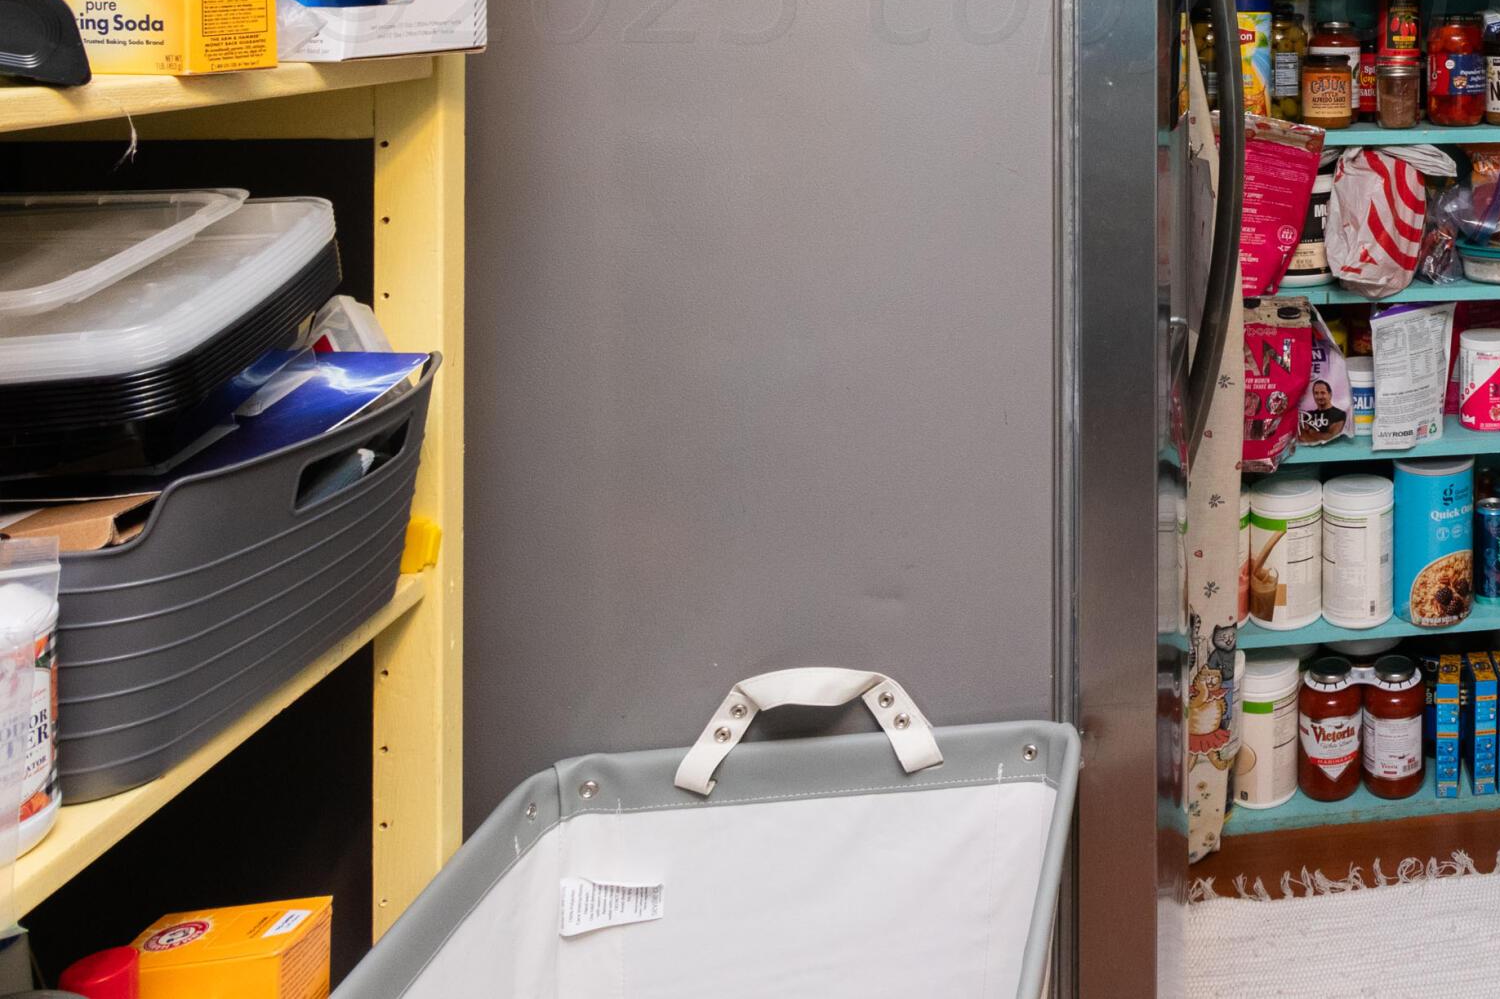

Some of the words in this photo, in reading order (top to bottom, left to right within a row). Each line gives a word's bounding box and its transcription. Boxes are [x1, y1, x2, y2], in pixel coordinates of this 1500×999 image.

[86, 0, 117, 12] pure
[113, 14, 164, 32] Soda
[106, 38, 127, 47] Baking
[1310, 81, 1347, 94] CAJUN
[1431, 509, 1460, 520] Quick
[1311, 723, 1355, 743] Victoria
